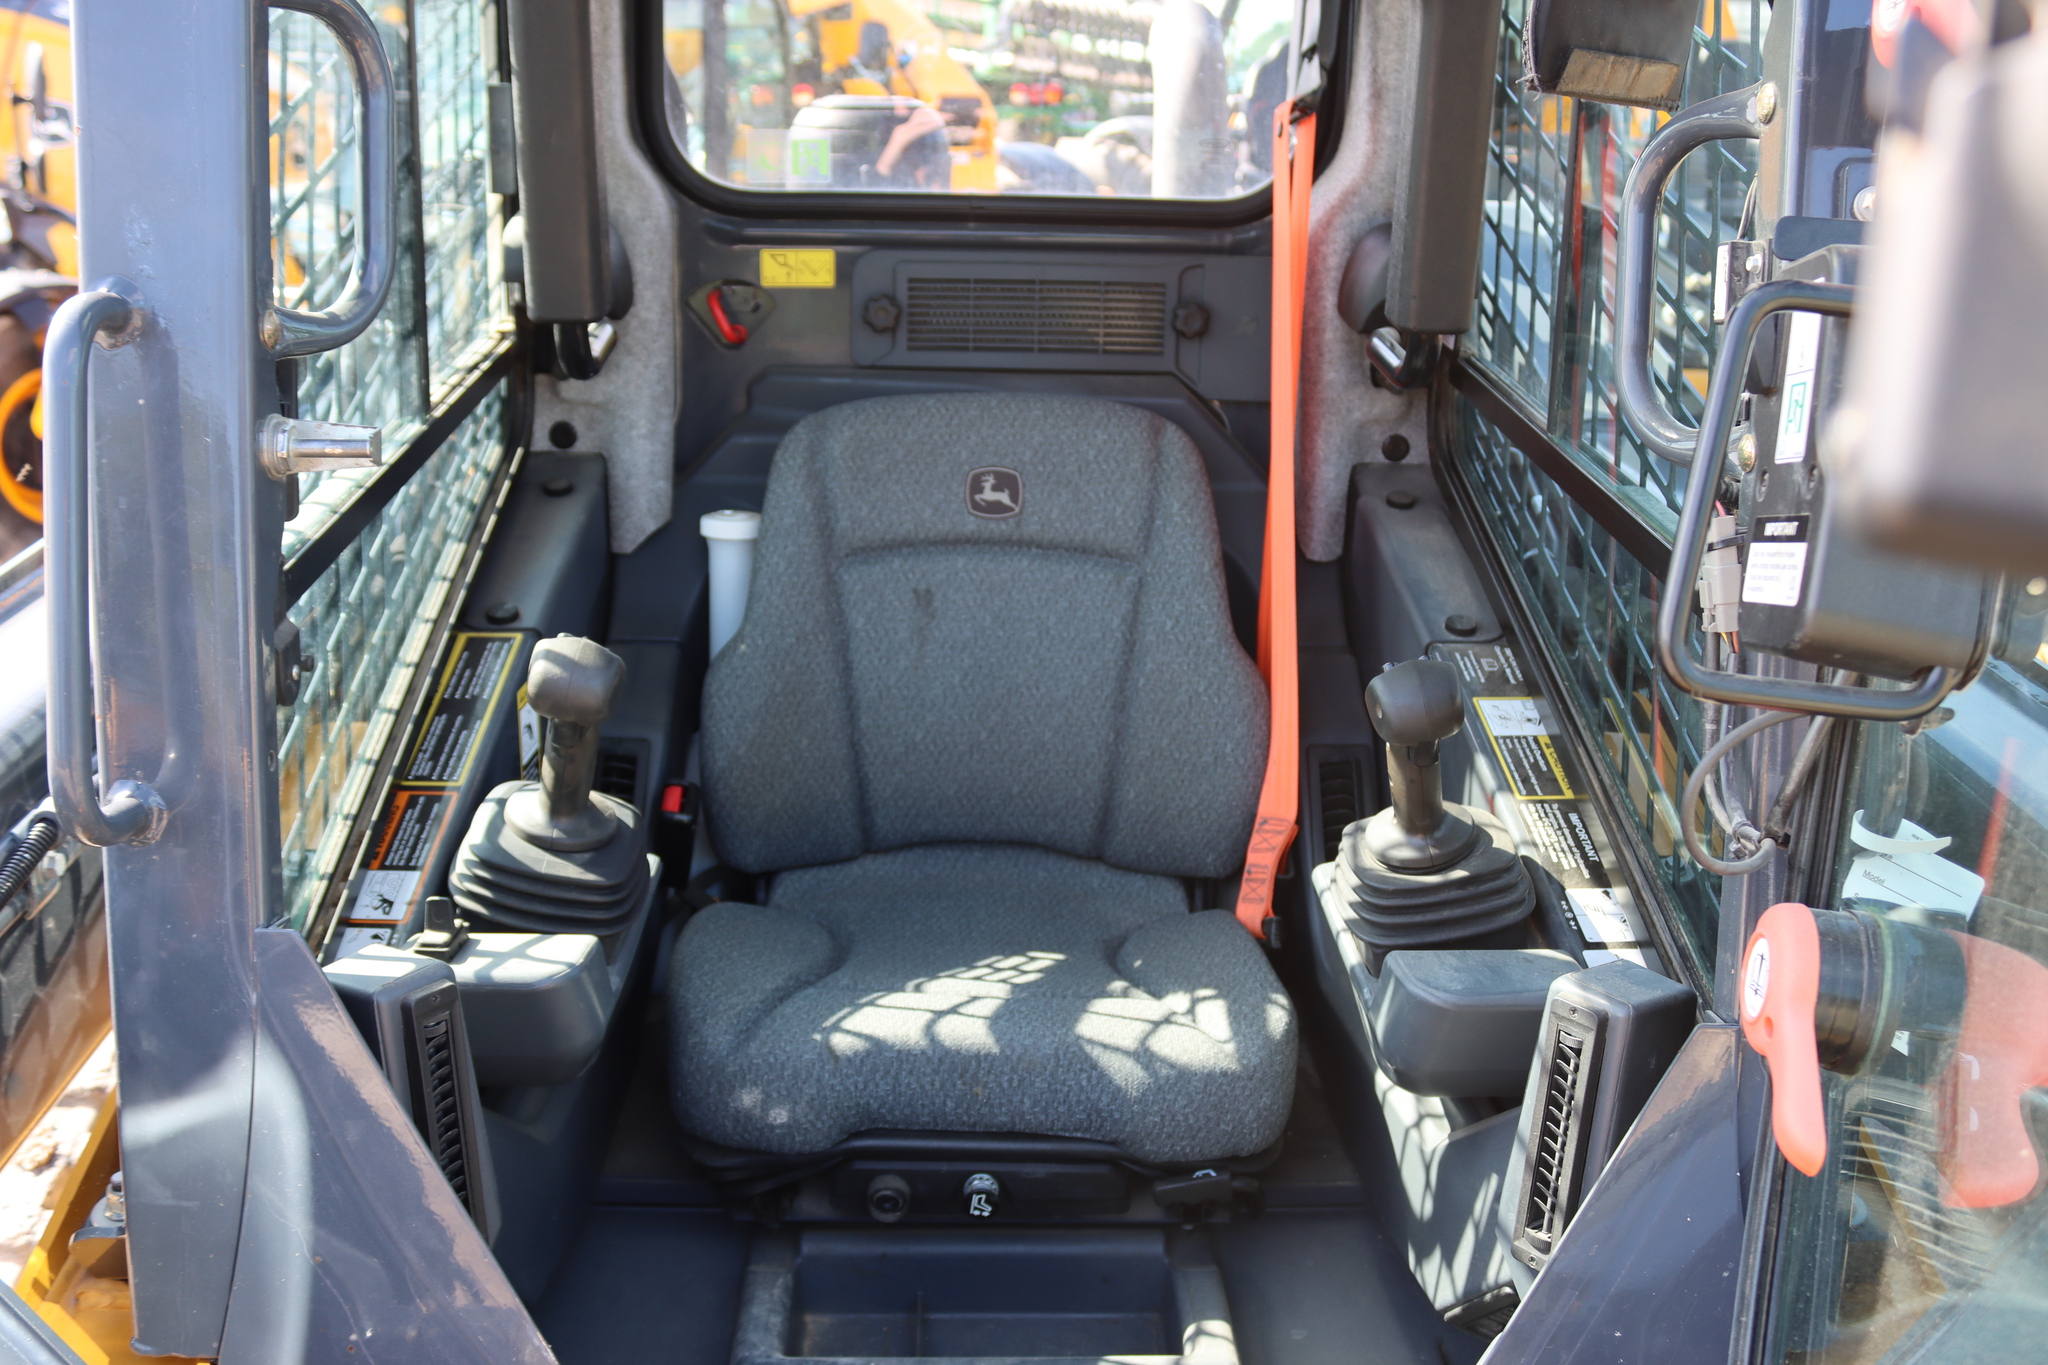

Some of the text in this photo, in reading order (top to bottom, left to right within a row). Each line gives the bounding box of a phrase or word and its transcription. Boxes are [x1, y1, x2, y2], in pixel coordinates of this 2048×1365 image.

[1562, 827, 1574, 846] damage
[1568, 812, 1600, 862] IMPORTANT
[1862, 869, 1886, 885] Model
